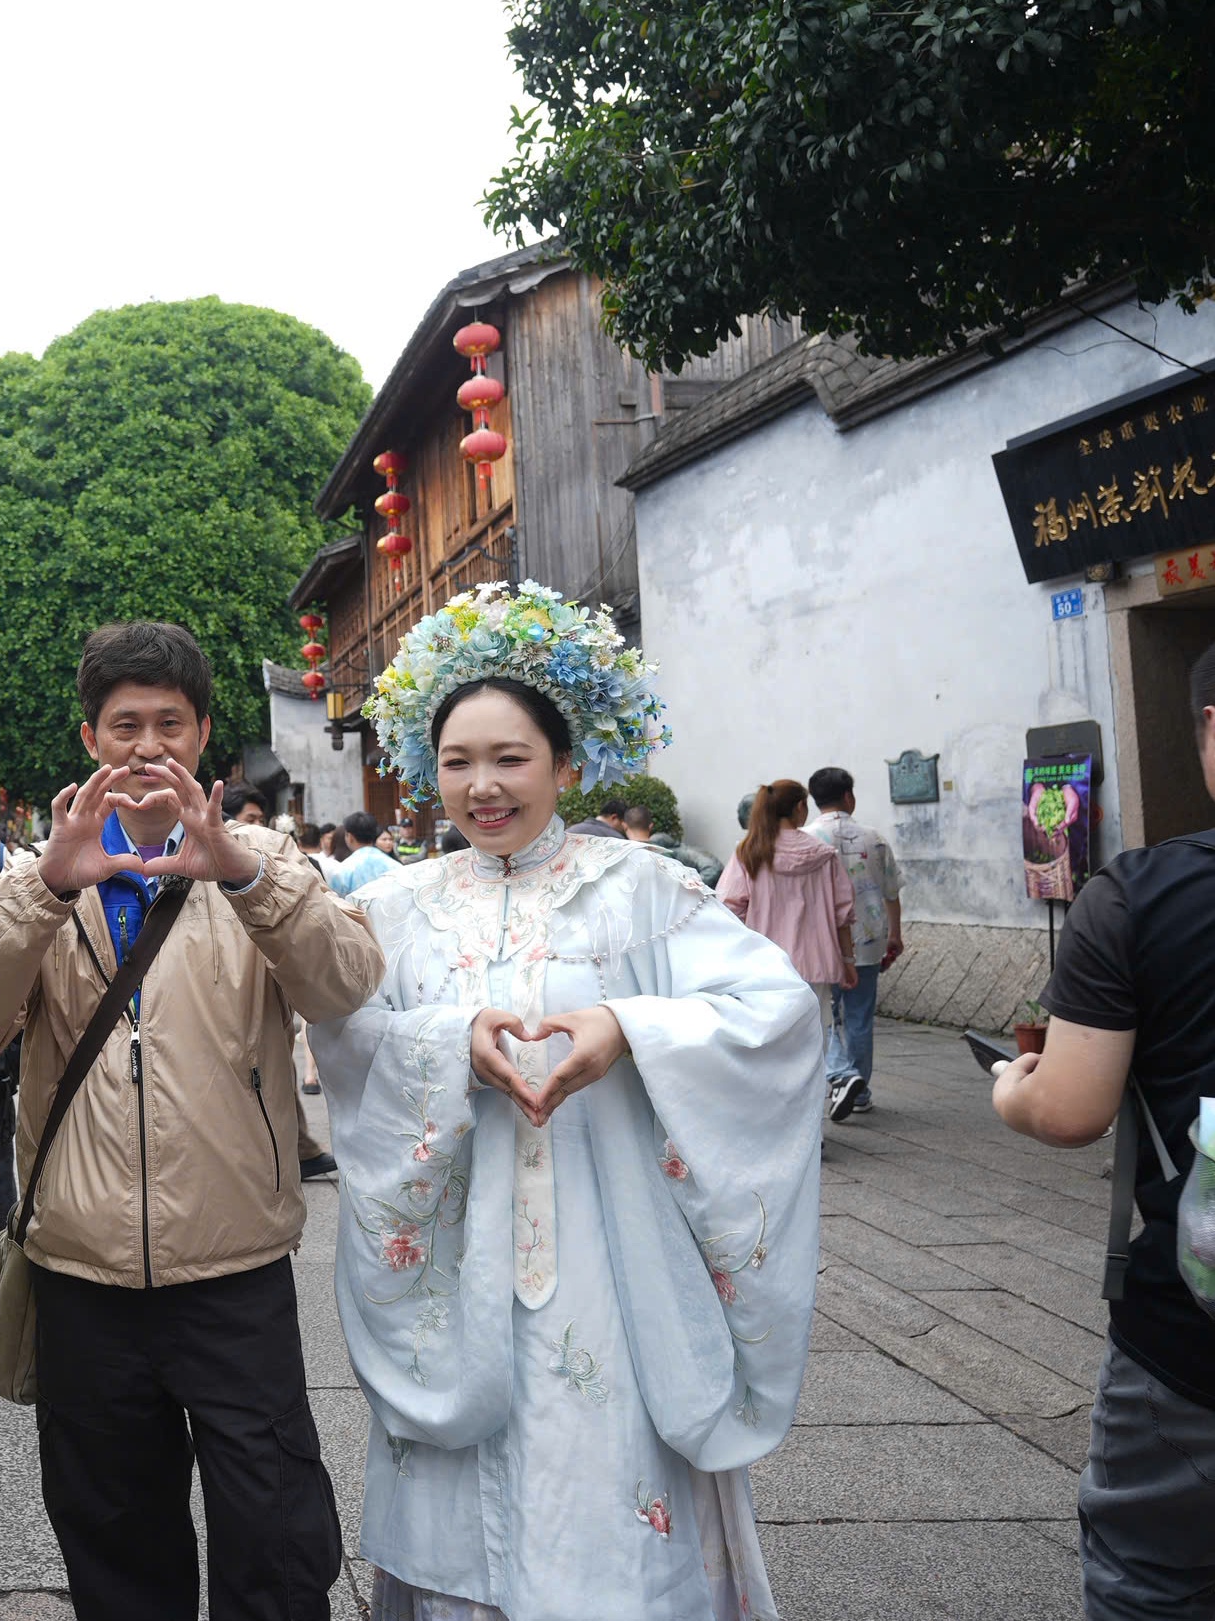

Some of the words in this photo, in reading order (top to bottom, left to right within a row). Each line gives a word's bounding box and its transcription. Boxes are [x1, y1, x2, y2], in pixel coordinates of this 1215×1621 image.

[1032, 455, 1215, 547] 福州茉莉花
[1057, 601, 1072, 616] 50
